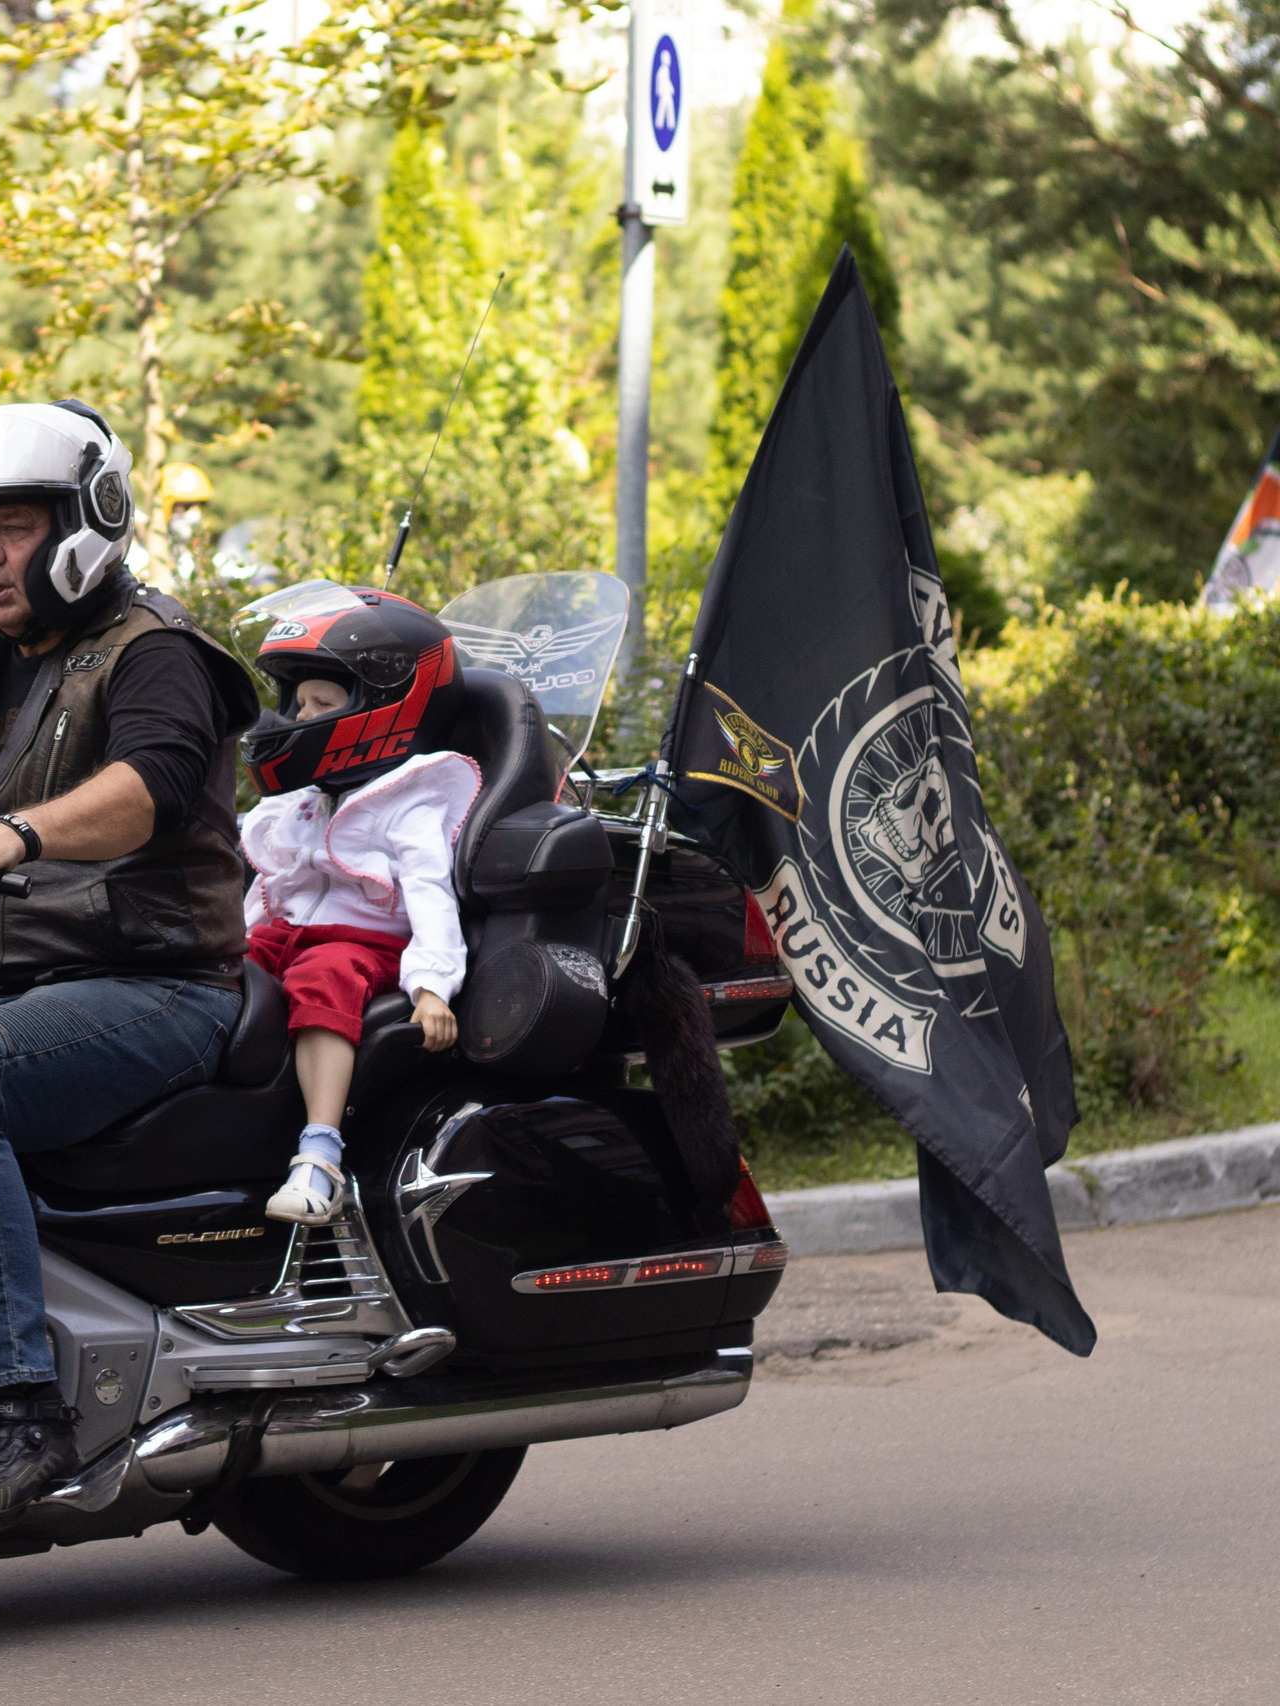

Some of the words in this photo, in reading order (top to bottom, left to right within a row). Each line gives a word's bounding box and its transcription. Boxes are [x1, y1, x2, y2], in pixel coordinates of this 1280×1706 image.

[312, 731, 415, 779] HJC
[719, 759, 755, 786] RIDERS
[756, 779, 779, 801] CLUB
[766, 884, 908, 1055] RUSSIA
